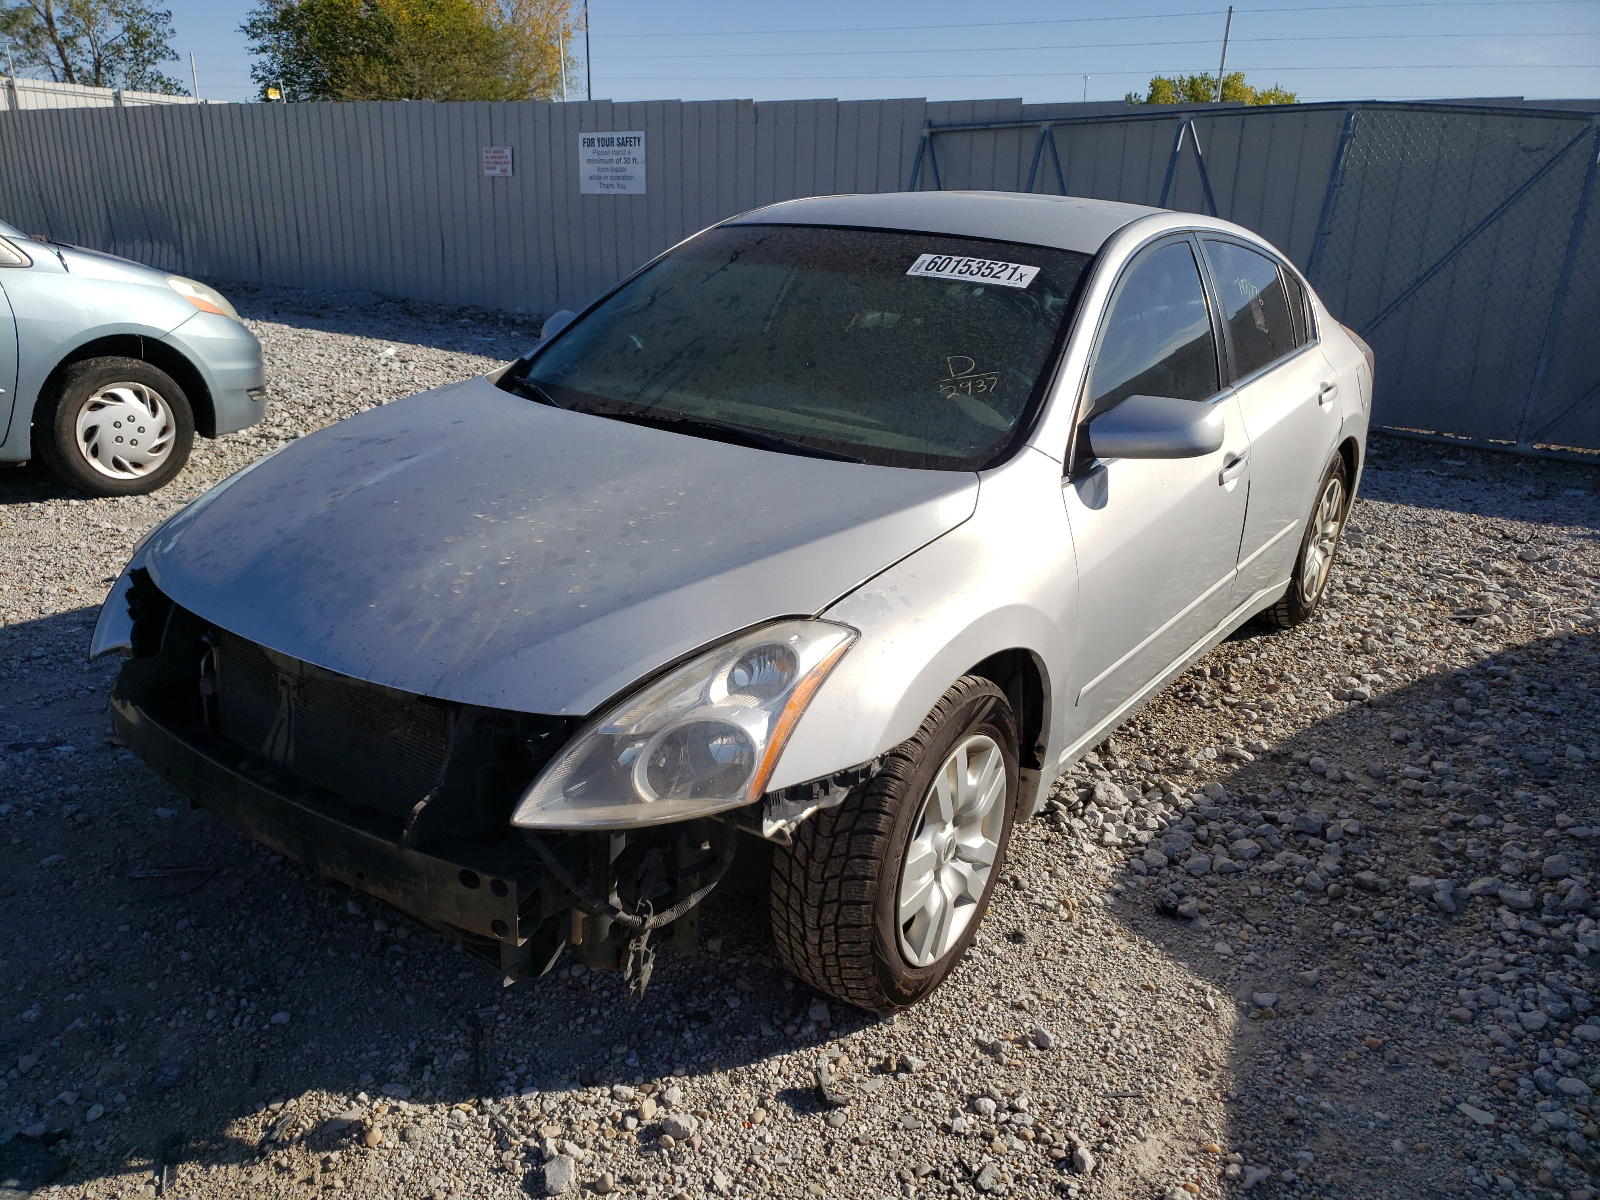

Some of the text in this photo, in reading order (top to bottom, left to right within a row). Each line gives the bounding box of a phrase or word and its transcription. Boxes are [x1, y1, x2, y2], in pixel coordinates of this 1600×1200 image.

[582, 136, 641, 148] FOR YOUR SAFETY
[946, 355, 975, 377] D
